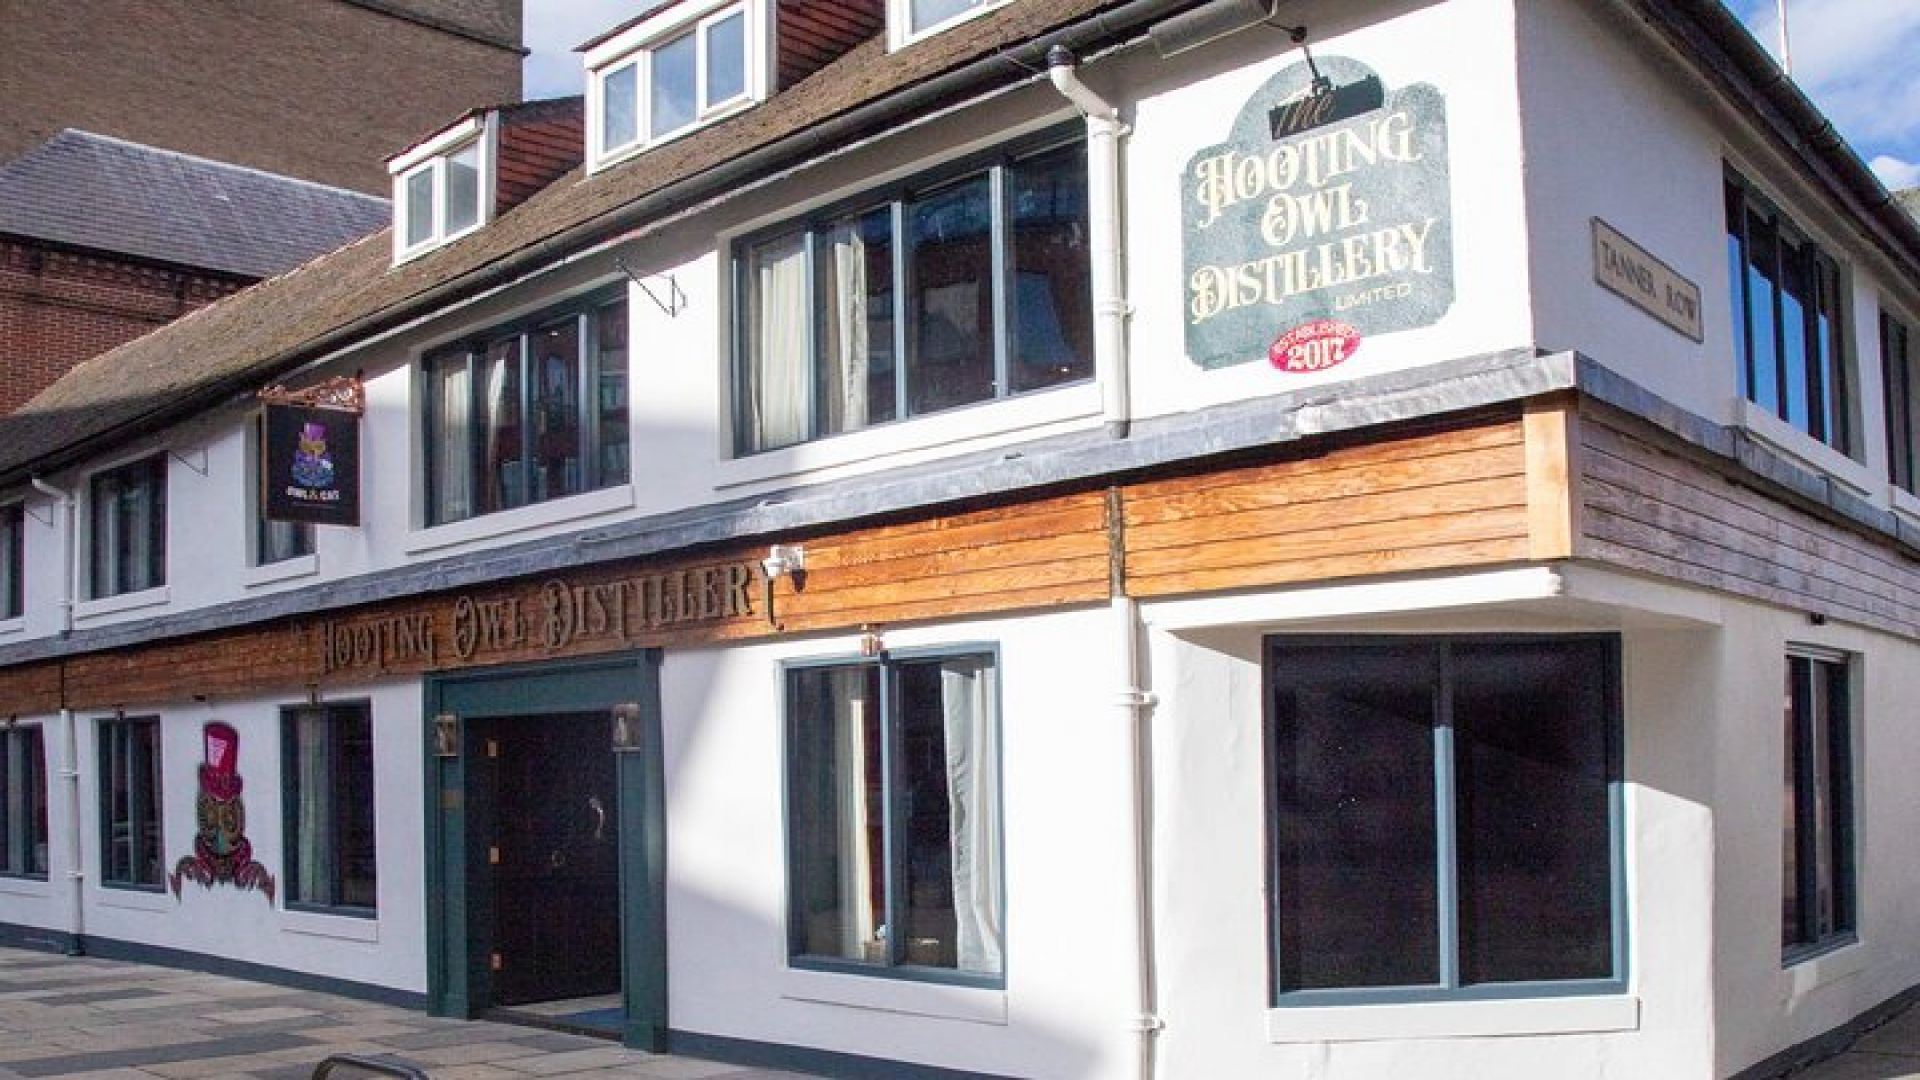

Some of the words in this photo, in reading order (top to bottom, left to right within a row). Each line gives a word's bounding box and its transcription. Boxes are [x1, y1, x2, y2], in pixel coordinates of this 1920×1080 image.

[1196, 112, 1422, 228] HOOTING
[1261, 182, 1368, 246] OWL
[1191, 216, 1439, 325] DISTILLERY
[1335, 283, 1411, 311] LIMITED
[1600, 240, 1657, 298] TANNER
[1665, 283, 1696, 322] ROW
[1287, 337, 1345, 370] 2017
[319, 611, 434, 676] HOOTING
[455, 594, 527, 659] OWL
